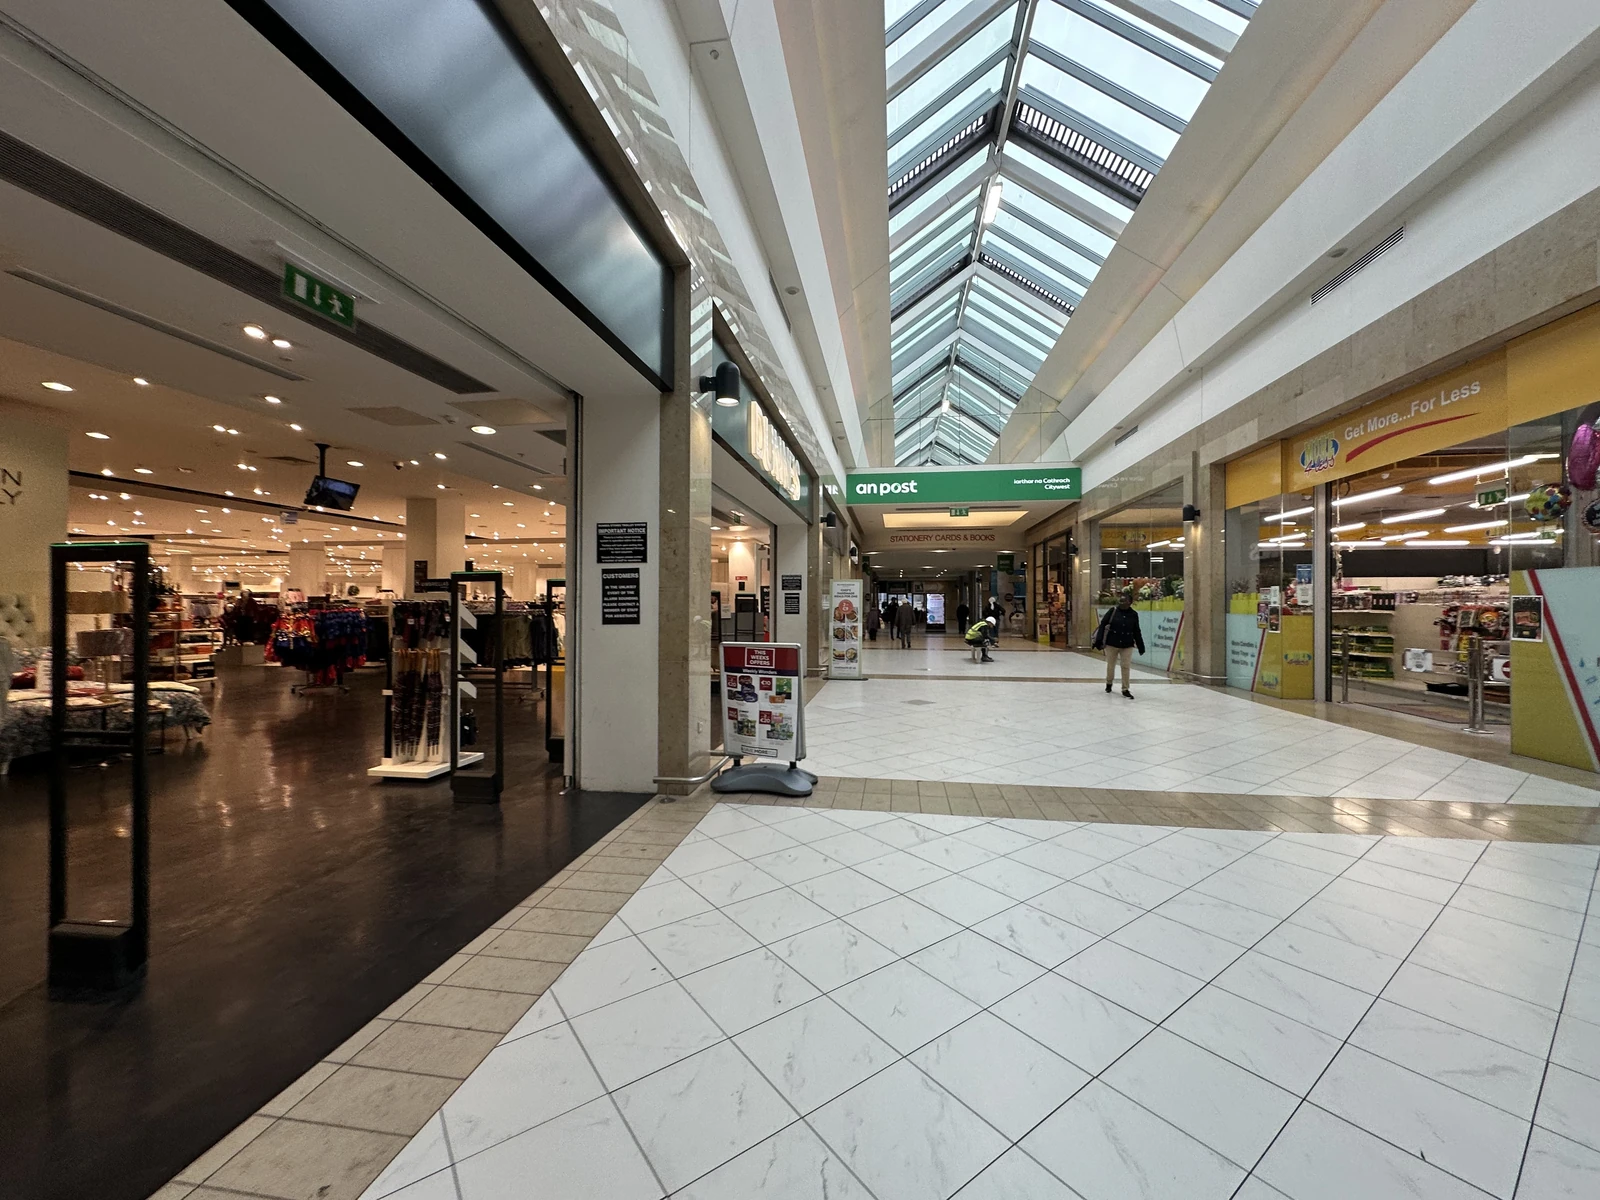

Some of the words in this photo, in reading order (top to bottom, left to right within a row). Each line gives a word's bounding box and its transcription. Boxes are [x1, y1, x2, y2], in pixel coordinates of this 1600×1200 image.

[1344, 427, 1365, 440] Get
[1440, 381, 1481, 407] Less
[855, 483, 878, 494] an
[879, 480, 918, 496] post
[890, 535, 933, 543] STATIONERY
[935, 534, 962, 542] CARDS
